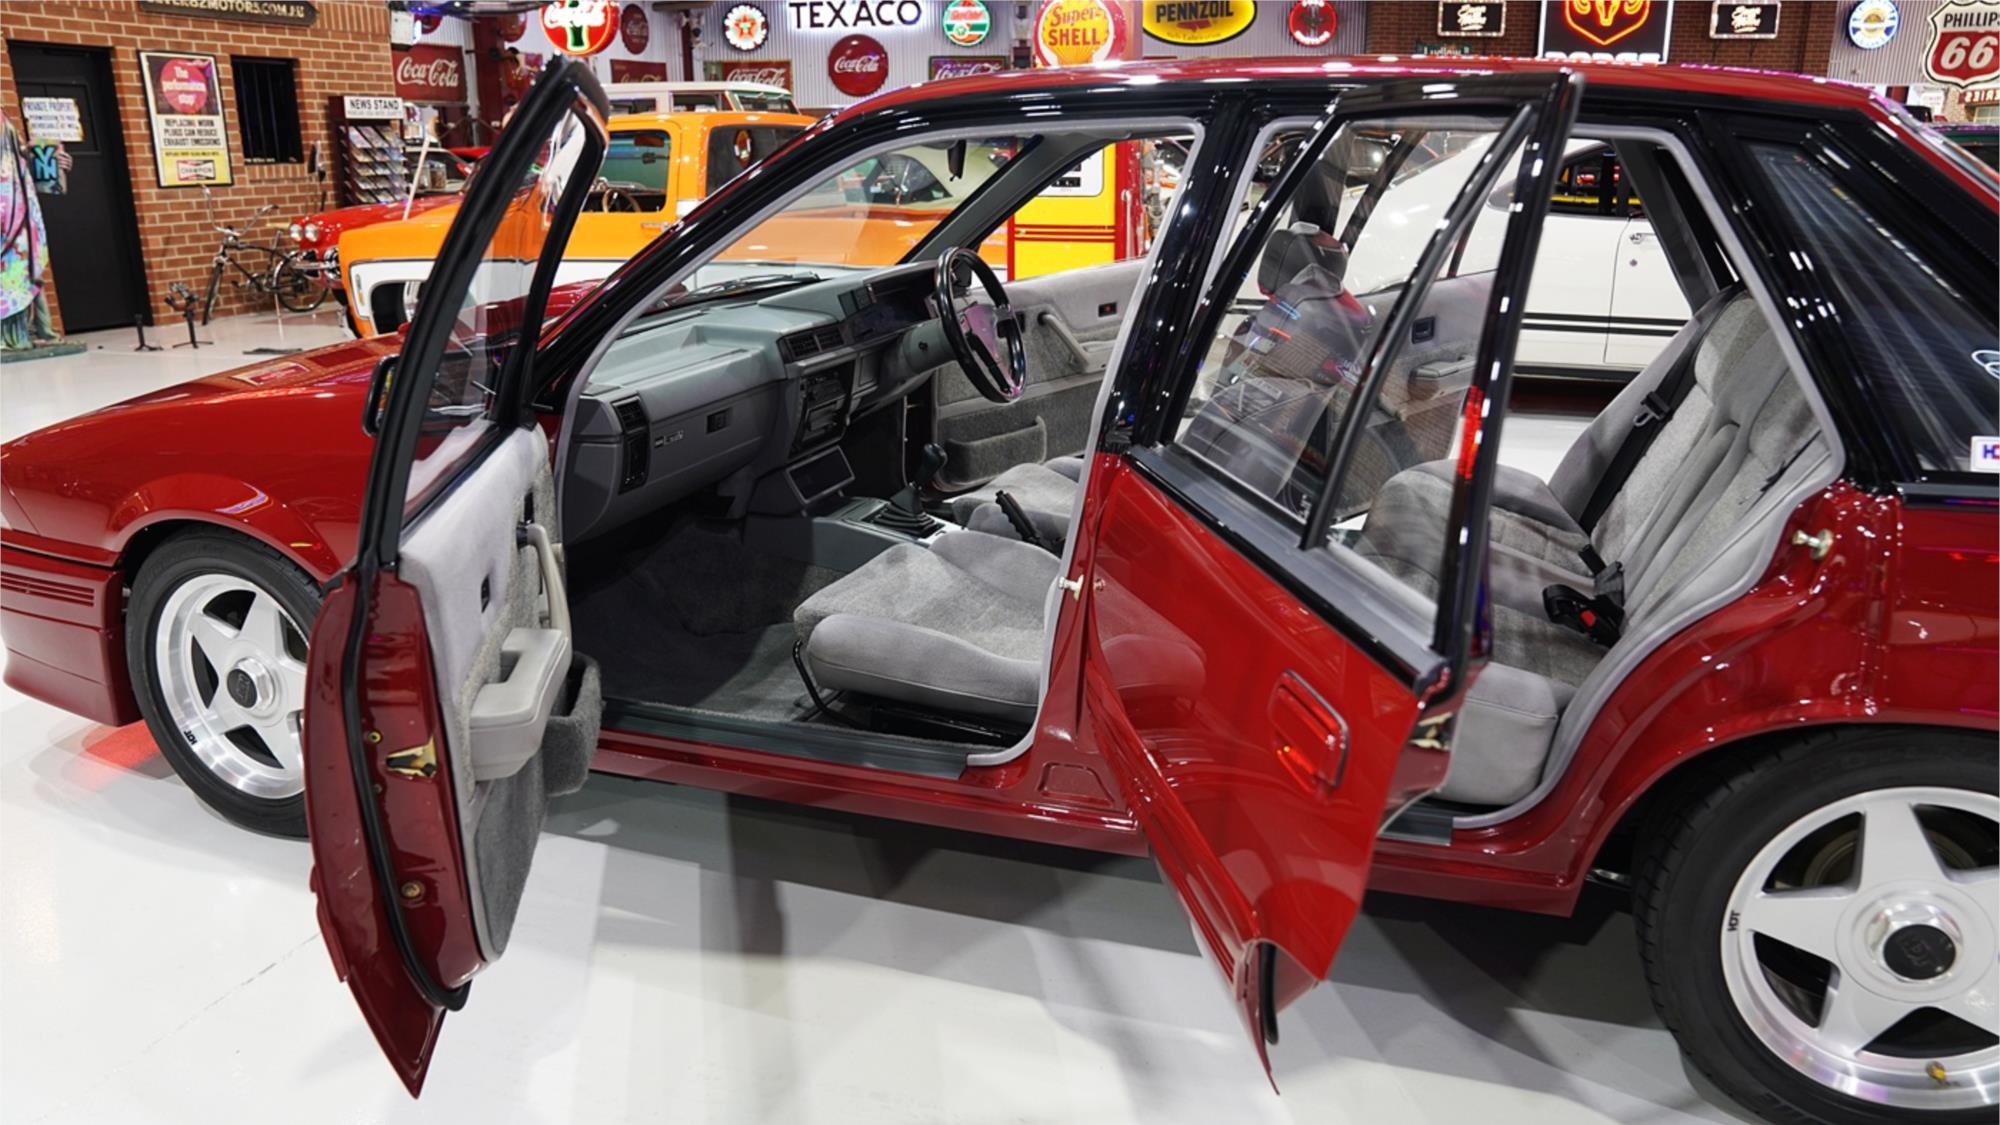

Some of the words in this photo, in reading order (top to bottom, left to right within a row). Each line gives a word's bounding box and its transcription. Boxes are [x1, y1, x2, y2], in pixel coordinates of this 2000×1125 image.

[788, 0, 922, 29] TEXACO
[1156, 0, 1234, 23] PENNZOIL
[1047, 28, 1101, 46] SHELL
[834, 55, 880, 74] Coca-Cola
[1940, 36, 1999, 70] 66
[397, 56, 459, 87] Coca-Cola
[350, 99, 372, 110] NEWS
[374, 99, 400, 110] STAND
